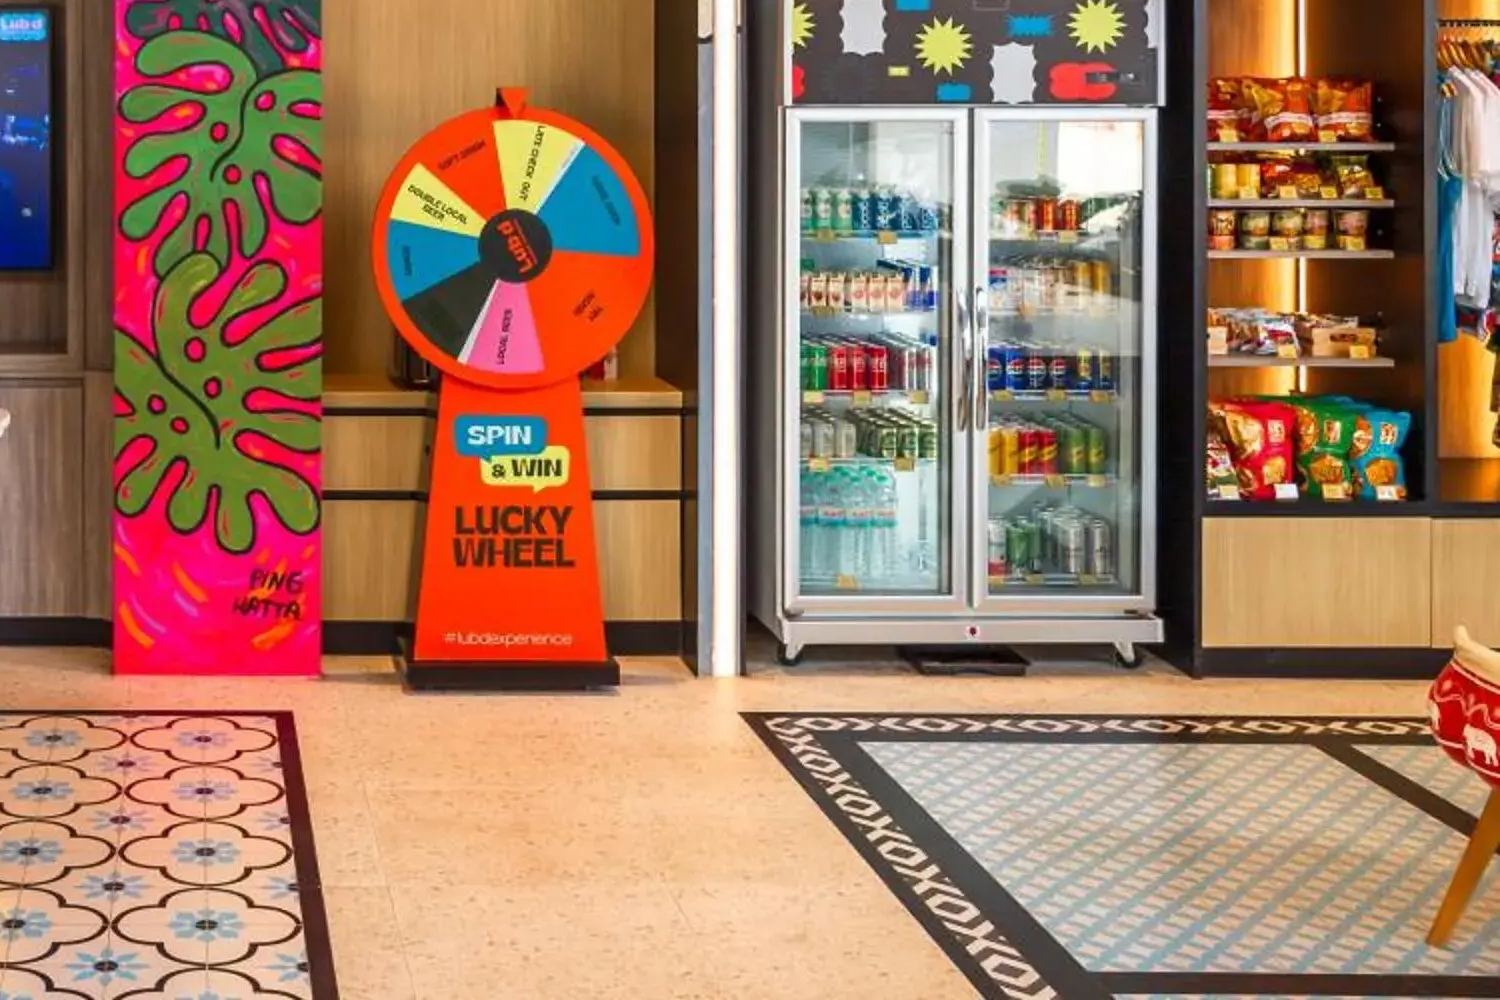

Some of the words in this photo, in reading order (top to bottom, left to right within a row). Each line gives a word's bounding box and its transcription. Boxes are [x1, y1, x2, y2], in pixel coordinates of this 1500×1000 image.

[467, 425, 532, 445] SPIN
[491, 463, 506, 478] &
[511, 458, 563, 477] WIN
[455, 505, 573, 535] LUCKY
[453, 537, 575, 568] WHEEL
